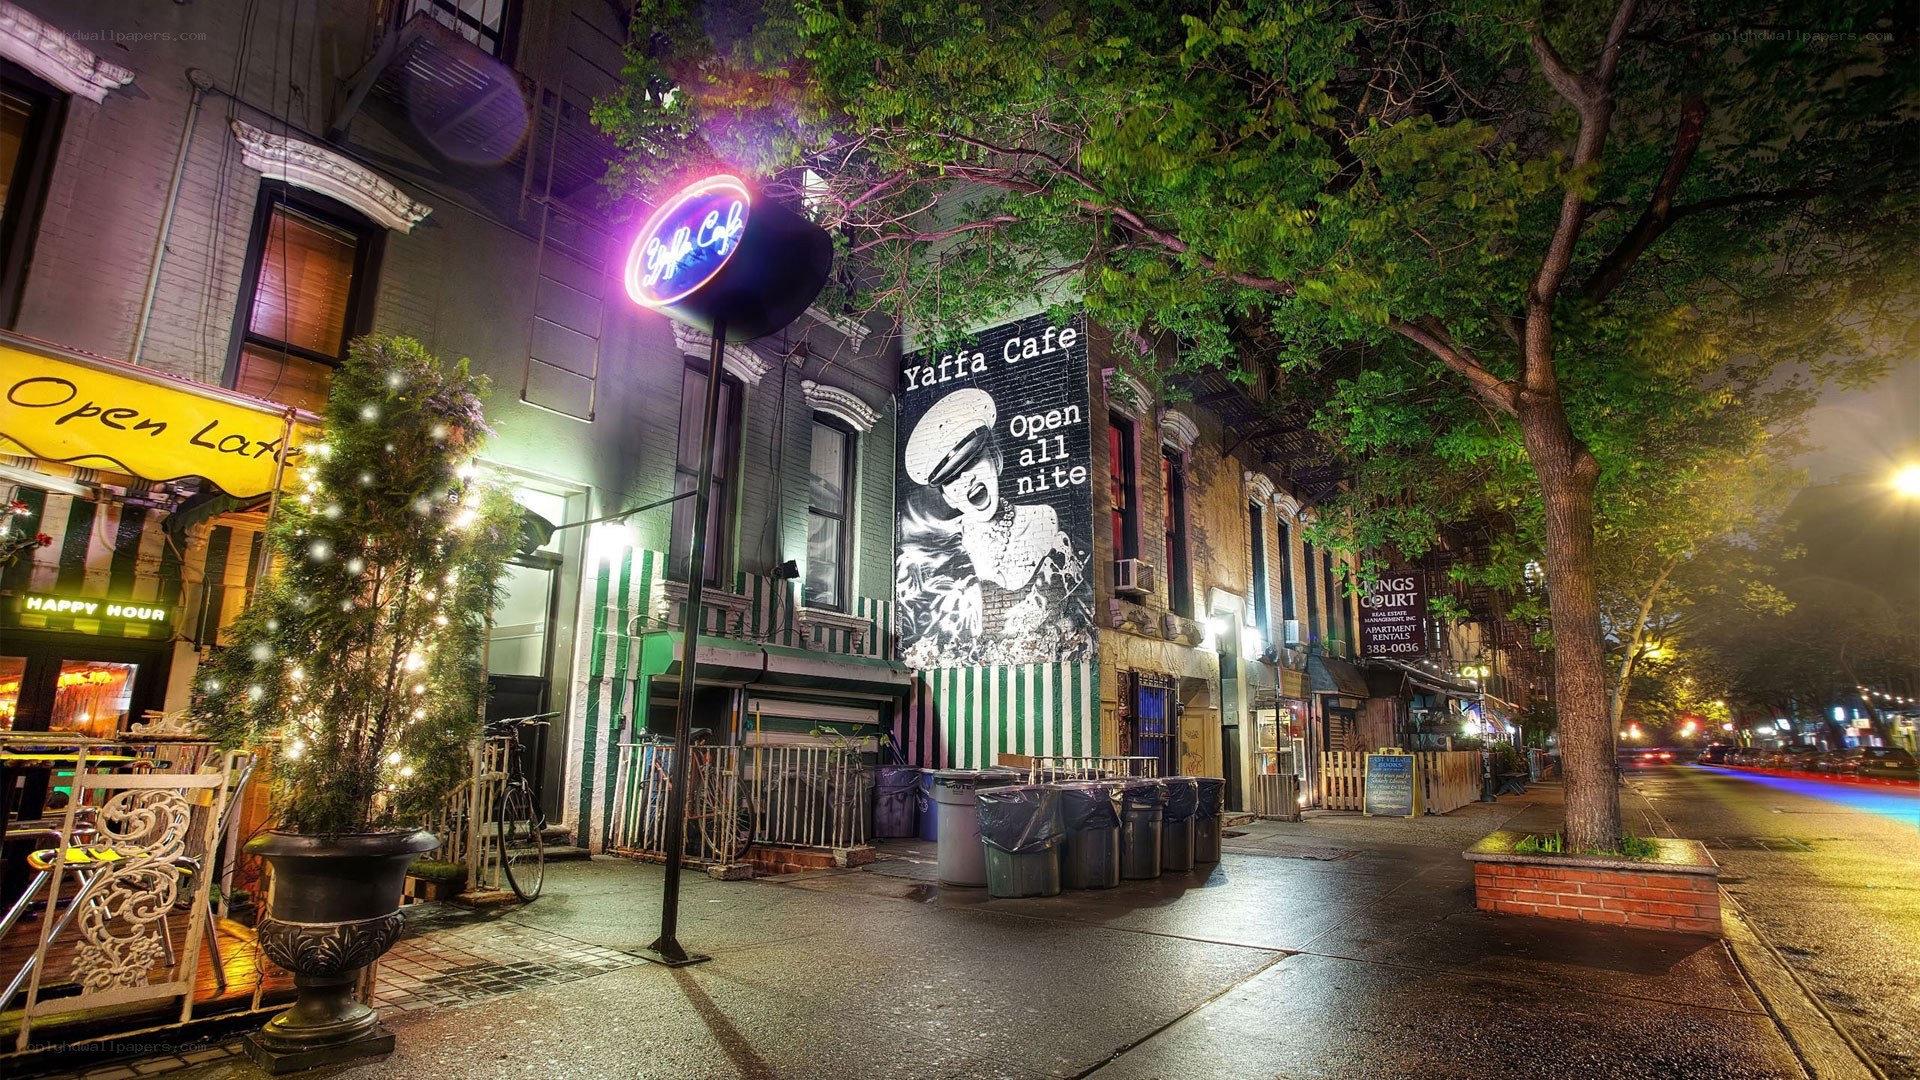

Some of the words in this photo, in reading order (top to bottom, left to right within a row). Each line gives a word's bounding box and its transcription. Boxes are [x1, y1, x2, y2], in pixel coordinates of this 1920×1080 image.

[643, 226, 694, 288] Yaffa
[697, 200, 744, 256] Cafe
[904, 350, 988, 391] Yaffa
[1003, 326, 1077, 364] Cafe
[7, 376, 167, 436] Open
[190, 419, 302, 467] Late
[1010, 404, 1082, 440] Open
[1019, 434, 1070, 467] all
[1017, 464, 1087, 495] nite
[26, 597, 98, 615] HAPPY
[106, 604, 165, 621] HOUR
[1361, 592, 1418, 608] COURT
[1365, 625, 1417, 634] APARTMENT
[1373, 633, 1411, 641] RENTALS
[1367, 643, 1419, 654] 388-0036
